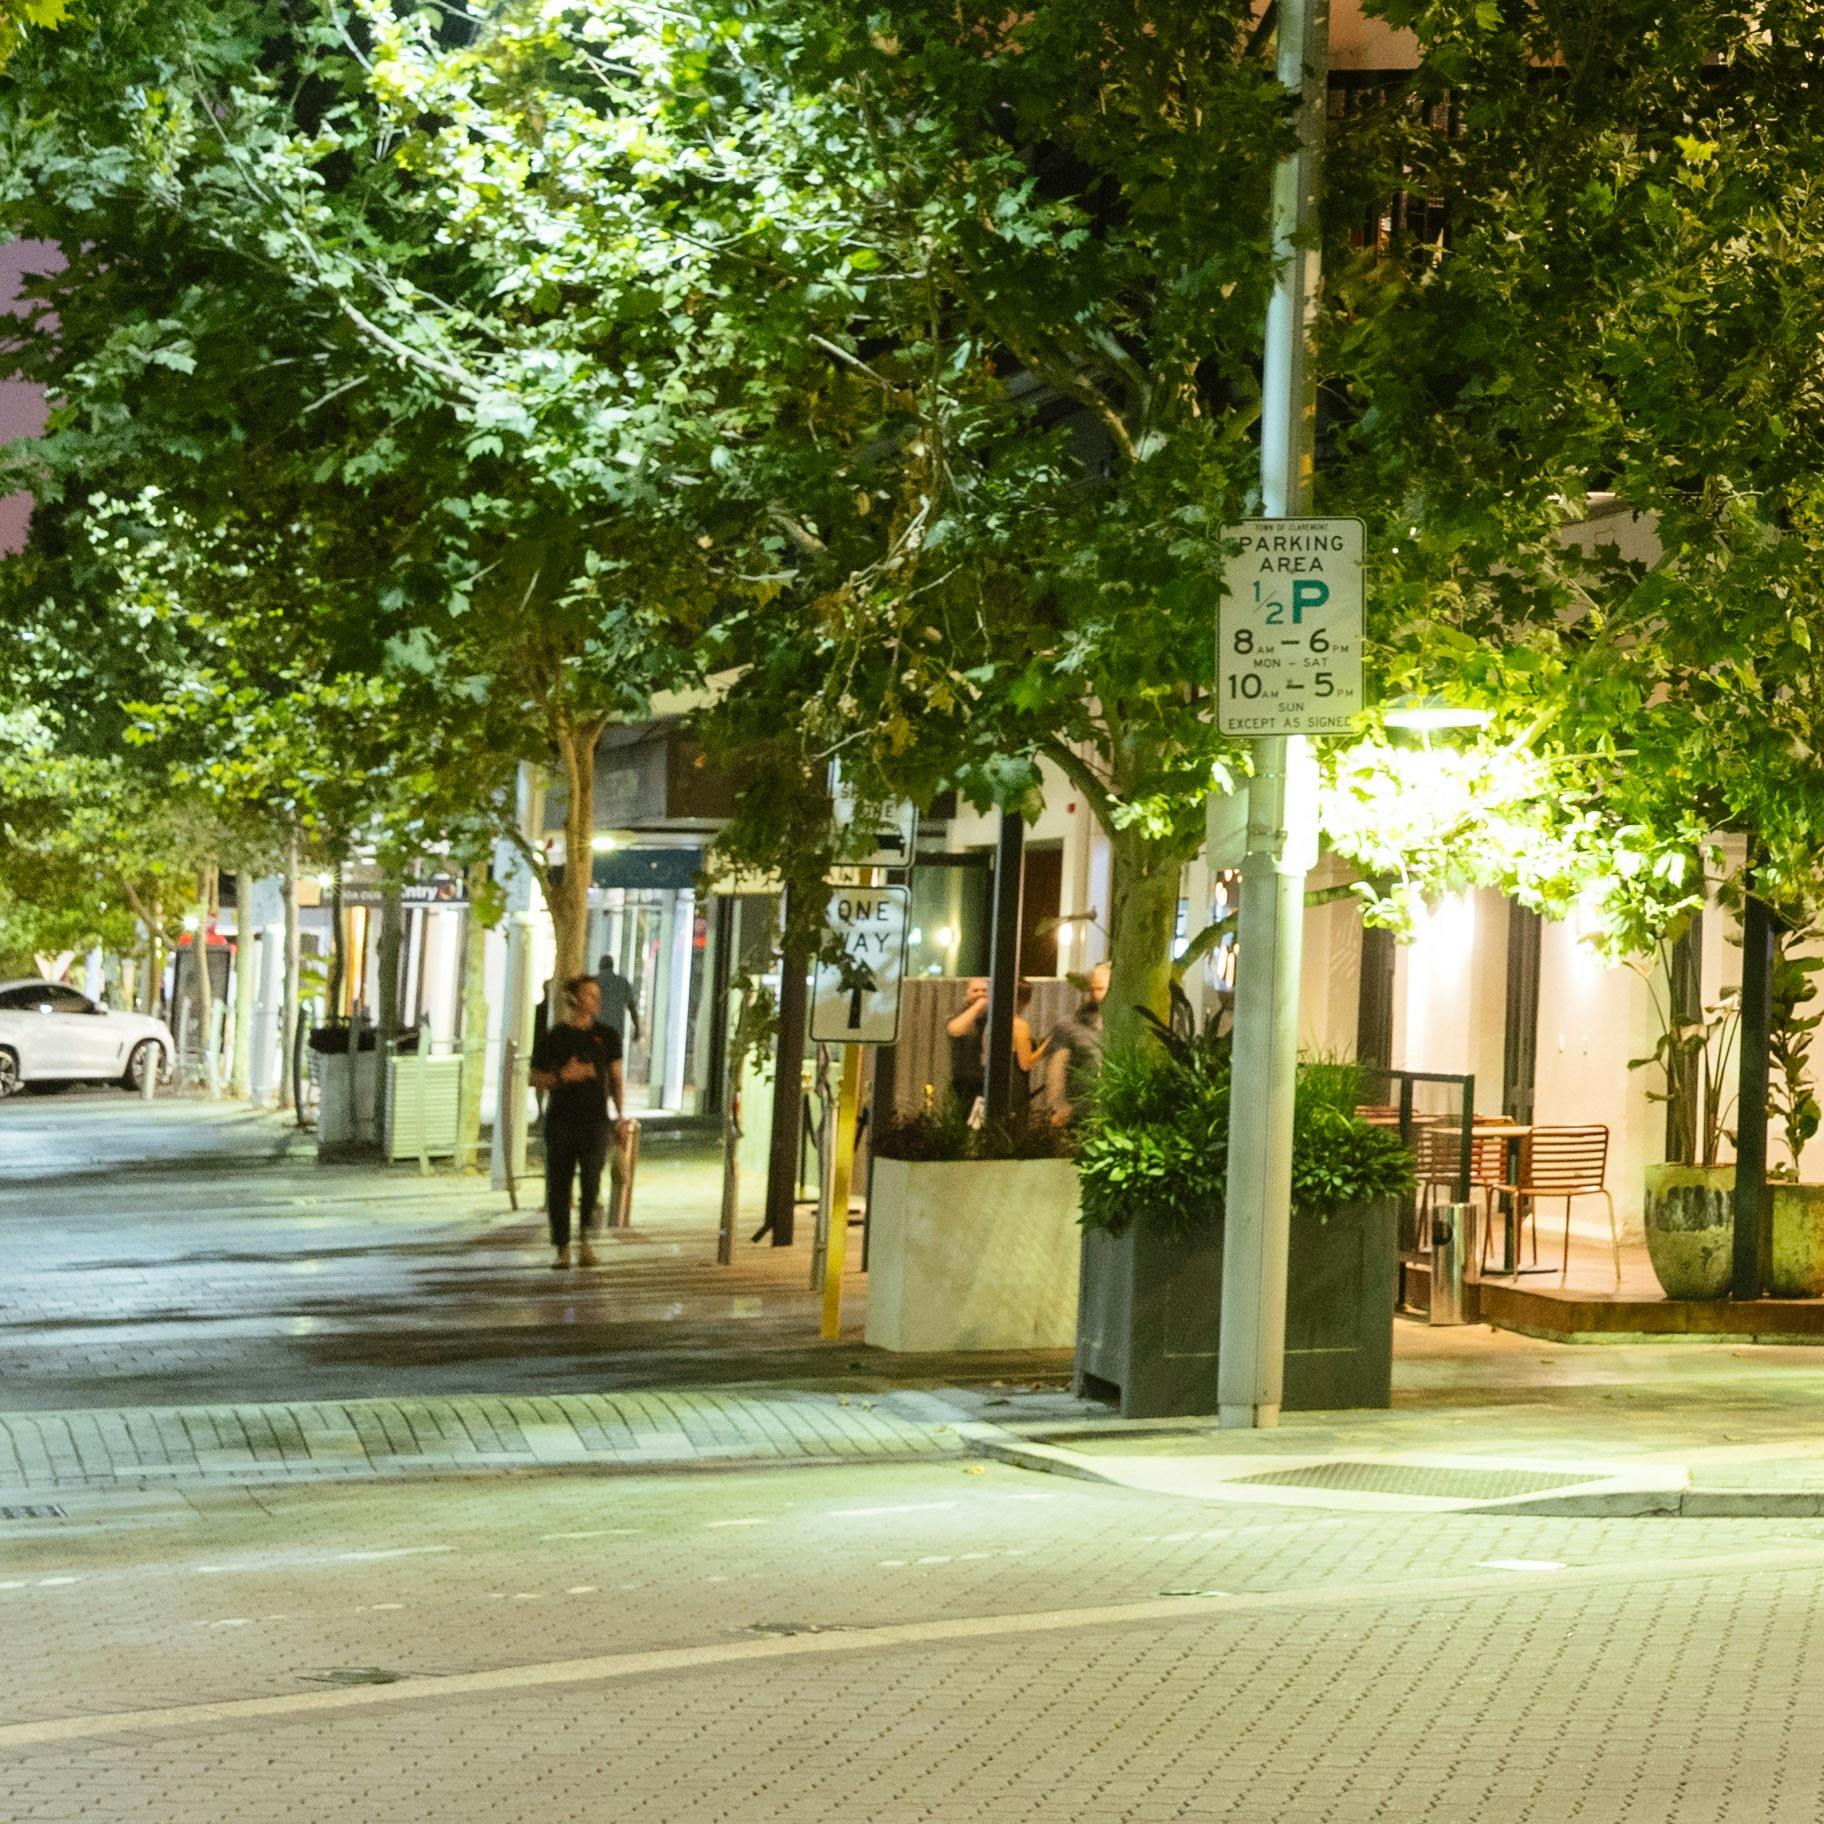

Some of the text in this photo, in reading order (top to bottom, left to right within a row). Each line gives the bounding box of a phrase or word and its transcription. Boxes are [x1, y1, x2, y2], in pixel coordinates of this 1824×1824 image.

[1240, 535, 1343, 552] PARKING
[1259, 556, 1324, 573] AREA
[1253, 658, 1281, 668] MON
[1303, 657, 1329, 667] SAT
[1278, 702, 1304, 713] SUN
[1228, 717, 1275, 729] EXCEPT
[1283, 717, 1300, 728] AS
[838, 900, 890, 922] ONE
